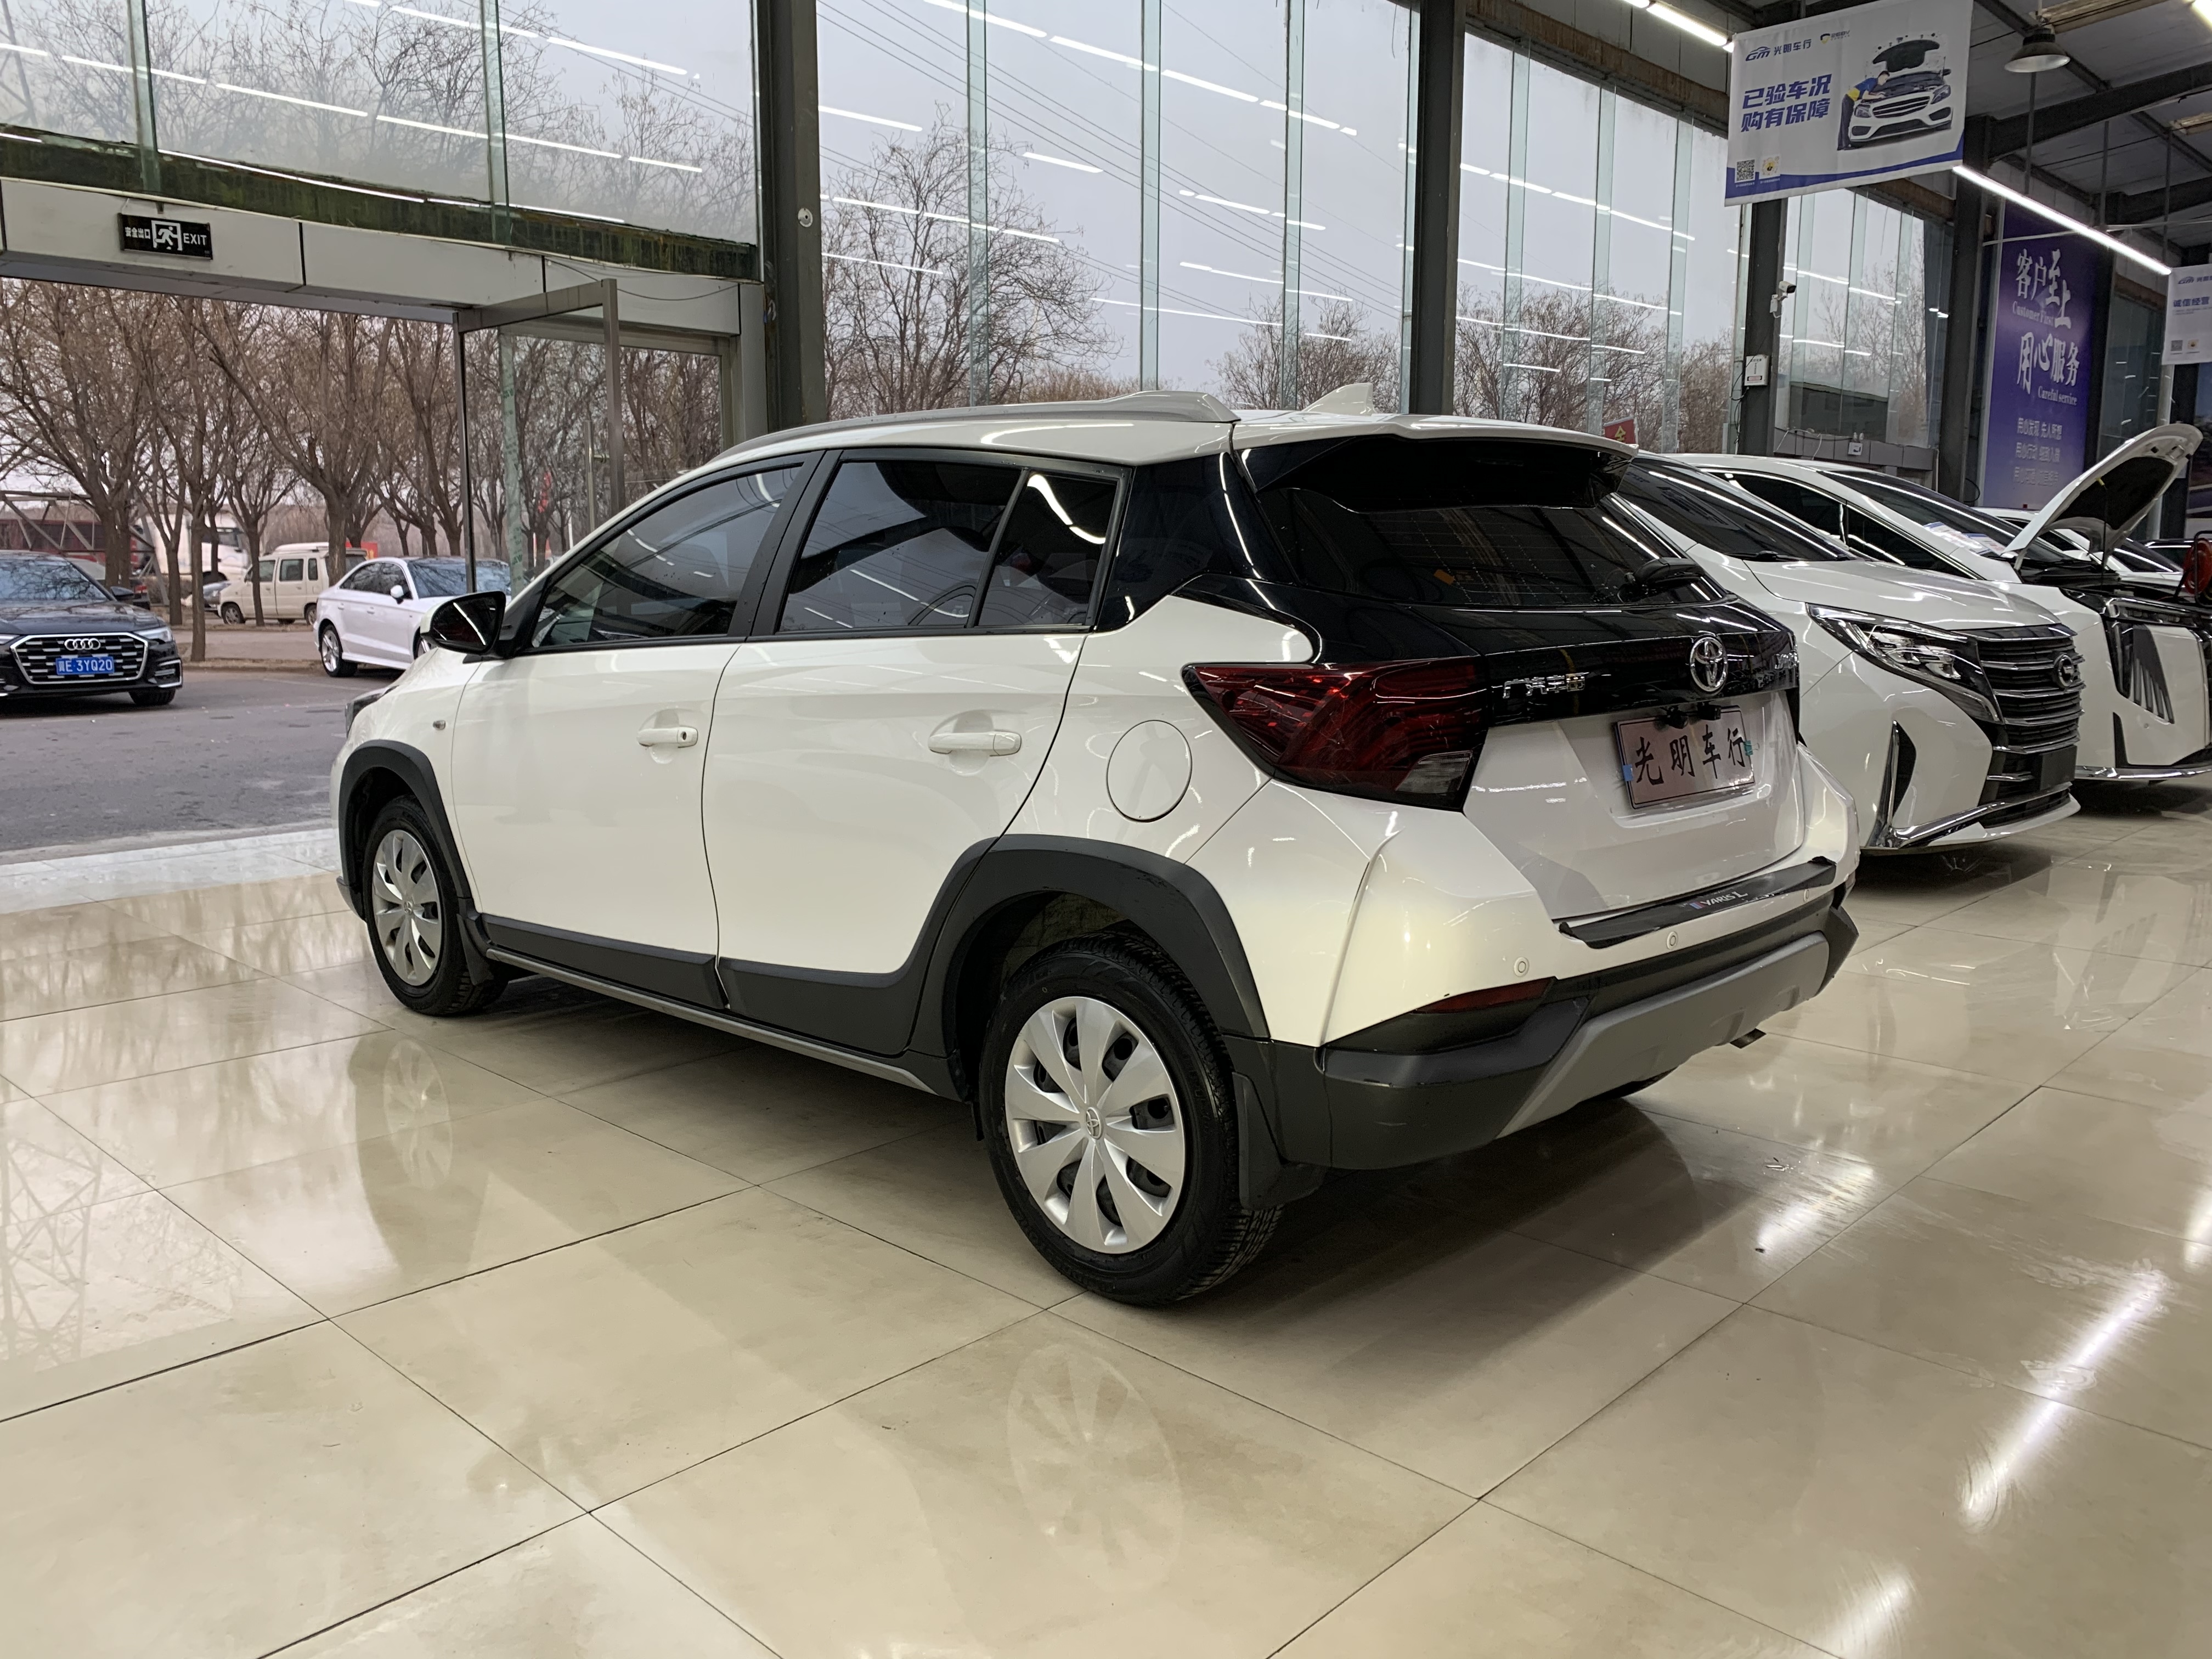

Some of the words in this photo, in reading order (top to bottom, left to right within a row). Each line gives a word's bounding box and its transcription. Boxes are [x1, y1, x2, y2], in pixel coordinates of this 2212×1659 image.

[1774, 39, 1812, 55] 光明车行
[1742, 74, 1832, 109] 已验车况
[1741, 98, 1830, 132] 购有保障
[125, 227, 151, 239] 安全出口
[183, 233, 207, 246] EXIT
[2016, 248, 2072, 329] 客户至上
[2017, 331, 2080, 394] 用心服务
[2038, 385, 2058, 402] Careful
[2058, 392, 2078, 405] service
[1635, 724, 1746, 785] 光明车行
[1700, 894, 1736, 906] YARIS
